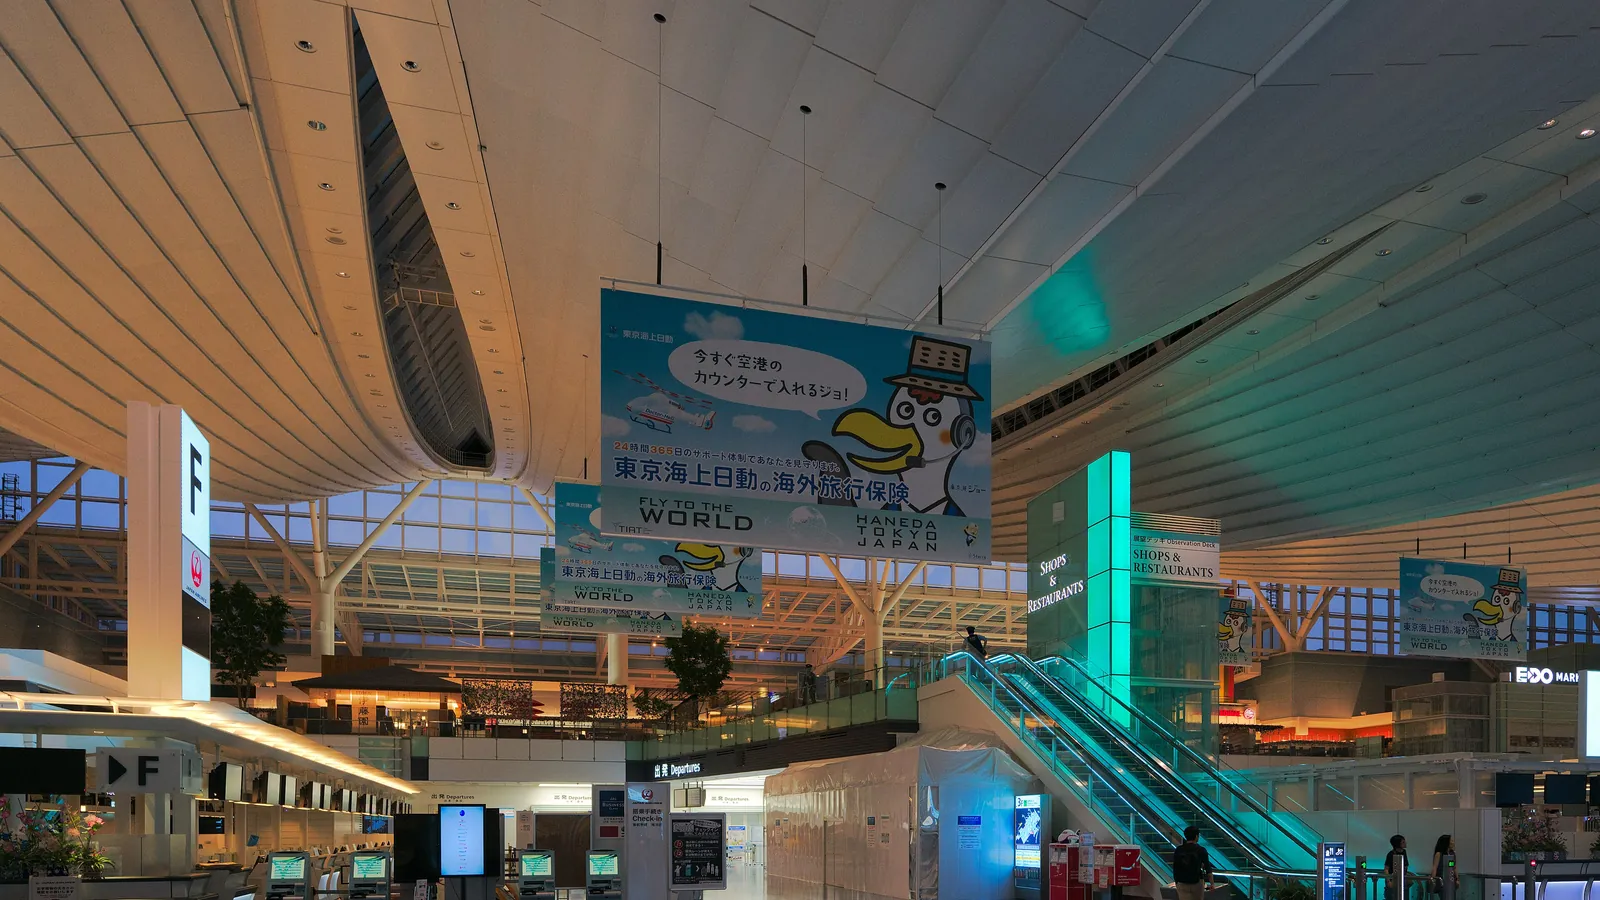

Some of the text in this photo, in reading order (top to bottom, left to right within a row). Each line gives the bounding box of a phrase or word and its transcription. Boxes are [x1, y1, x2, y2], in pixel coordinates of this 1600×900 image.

[622, 329, 674, 344] 東京海上日動
[693, 349, 783, 372] 今すぐ空港の
[694, 371, 849, 402] カウンターで入れるジョ!
[613, 441, 841, 474] 24時間365日のサポート体制であなたを見守ります。
[190, 442, 202, 516] F
[613, 456, 910, 505] 東京海上日動の海外旅行保険
[640, 497, 734, 513] FLY TO THE
[640, 507, 753, 531] WORLD
[856, 514, 937, 530] HANEDA
[857, 526, 937, 541] TOKYO
[857, 537, 937, 552] JAPAN
[1167, 538, 1201, 547] Observation
[1202, 541, 1216, 549] Deck
[1133, 549, 1181, 562] SHOPS &
[1133, 562, 1213, 578] RESTAURANTS
[1049, 574, 1057, 587] &
[574, 591, 634, 602] WORLD
[687, 591, 732, 600] HANEDA
[688, 598, 732, 606] TOKYO
[553, 619, 594, 628] WORLD
[1411, 642, 1448, 651] WORLD
[1516, 666, 1553, 684] EDO
[138, 756, 159, 786] F
[654, 763, 701, 778] 出発 Departures
